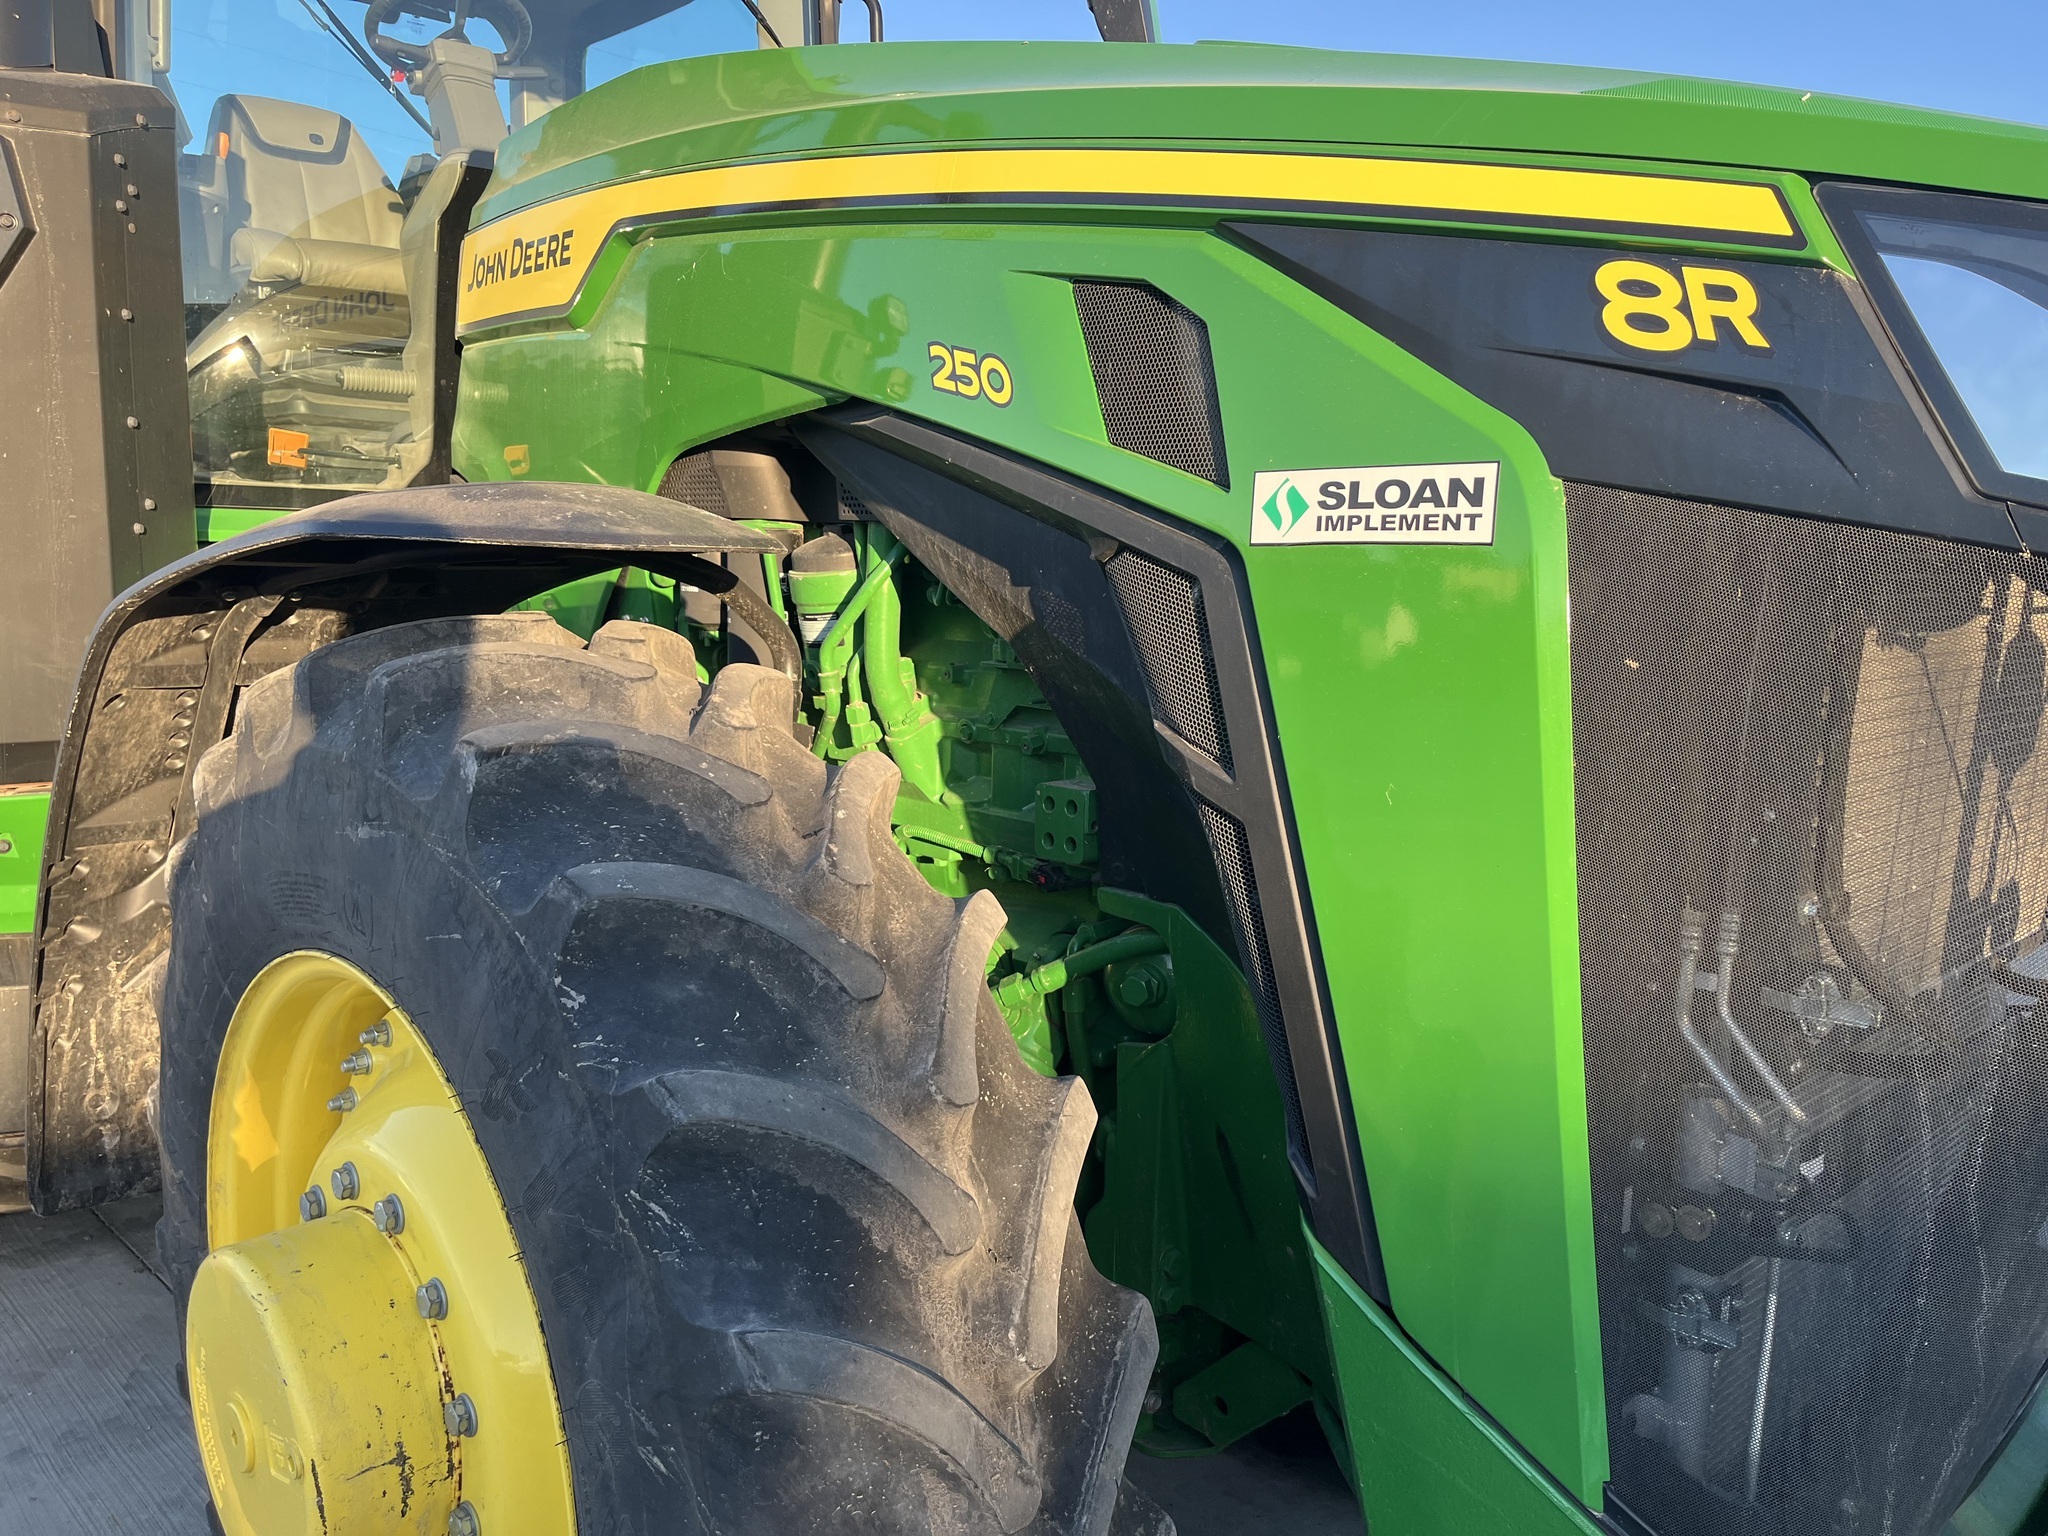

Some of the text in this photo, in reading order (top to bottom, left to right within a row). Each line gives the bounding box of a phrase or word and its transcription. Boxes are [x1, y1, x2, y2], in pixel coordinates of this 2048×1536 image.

[467, 229, 574, 292] JOHN DEERE
[1594, 259, 1771, 352] 8R
[927, 341, 1014, 409] 250
[1315, 513, 1483, 532] IMPLEMENT
[1316, 477, 1486, 511] SLOAN
